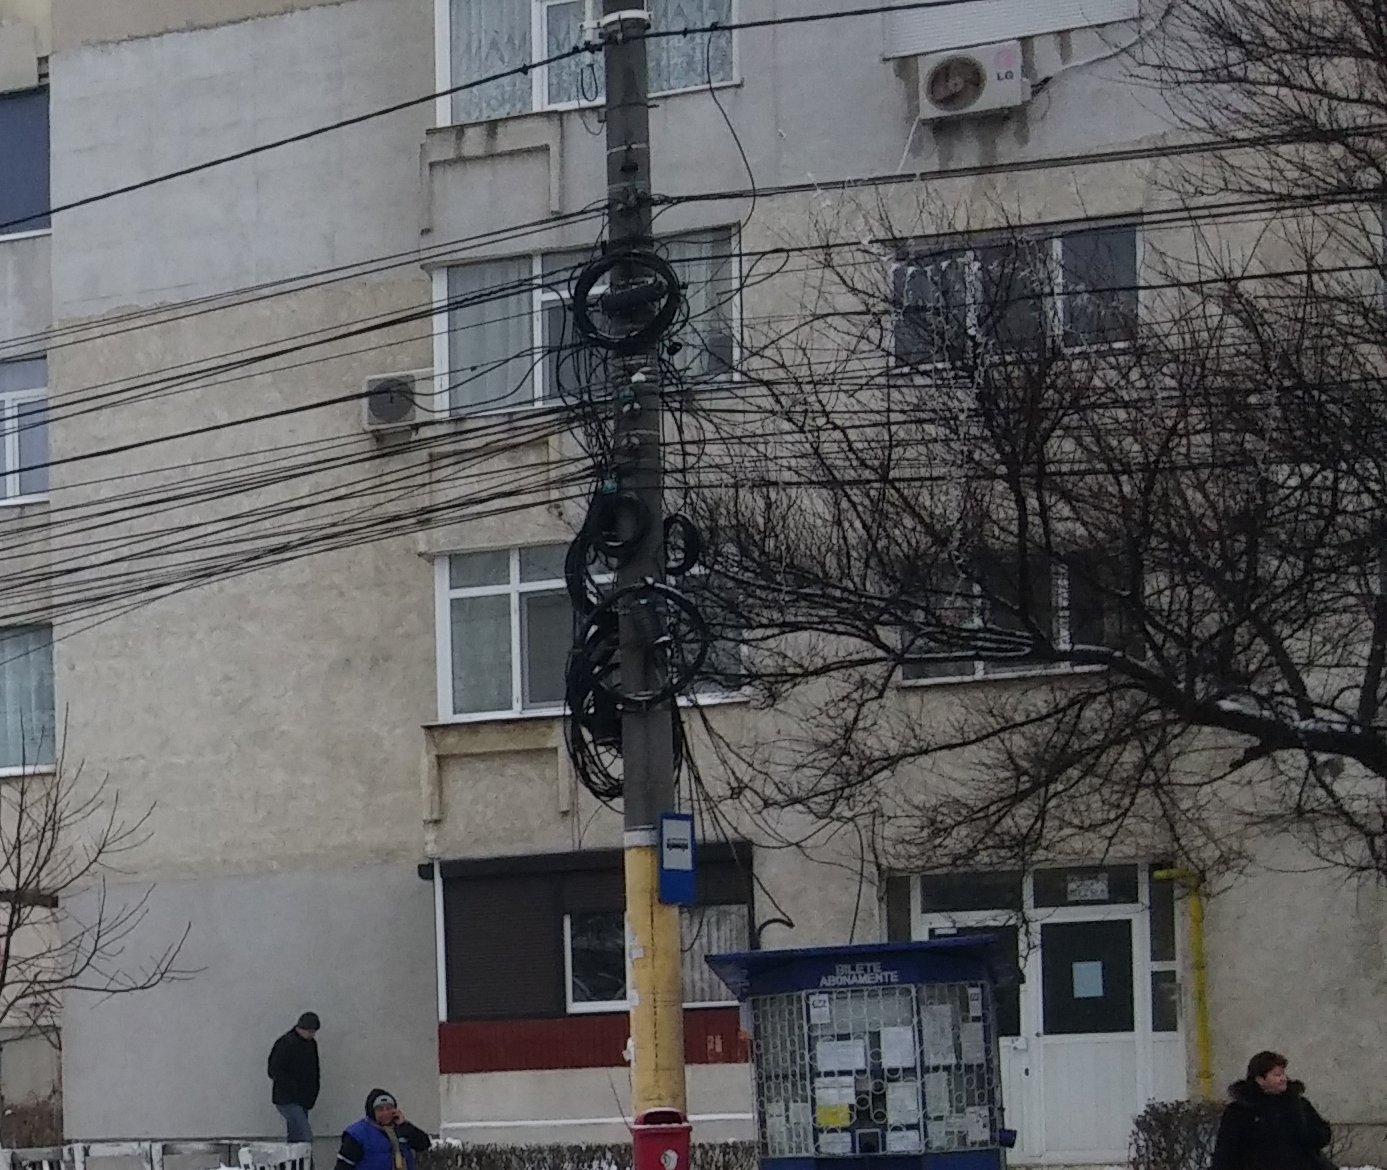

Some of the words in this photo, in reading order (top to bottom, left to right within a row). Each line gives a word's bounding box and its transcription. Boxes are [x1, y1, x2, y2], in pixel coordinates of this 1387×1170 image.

[996, 70, 1014, 81] LG
[835, 962, 882, 975] BILETE
[819, 970, 899, 987] ABONAMENTE
